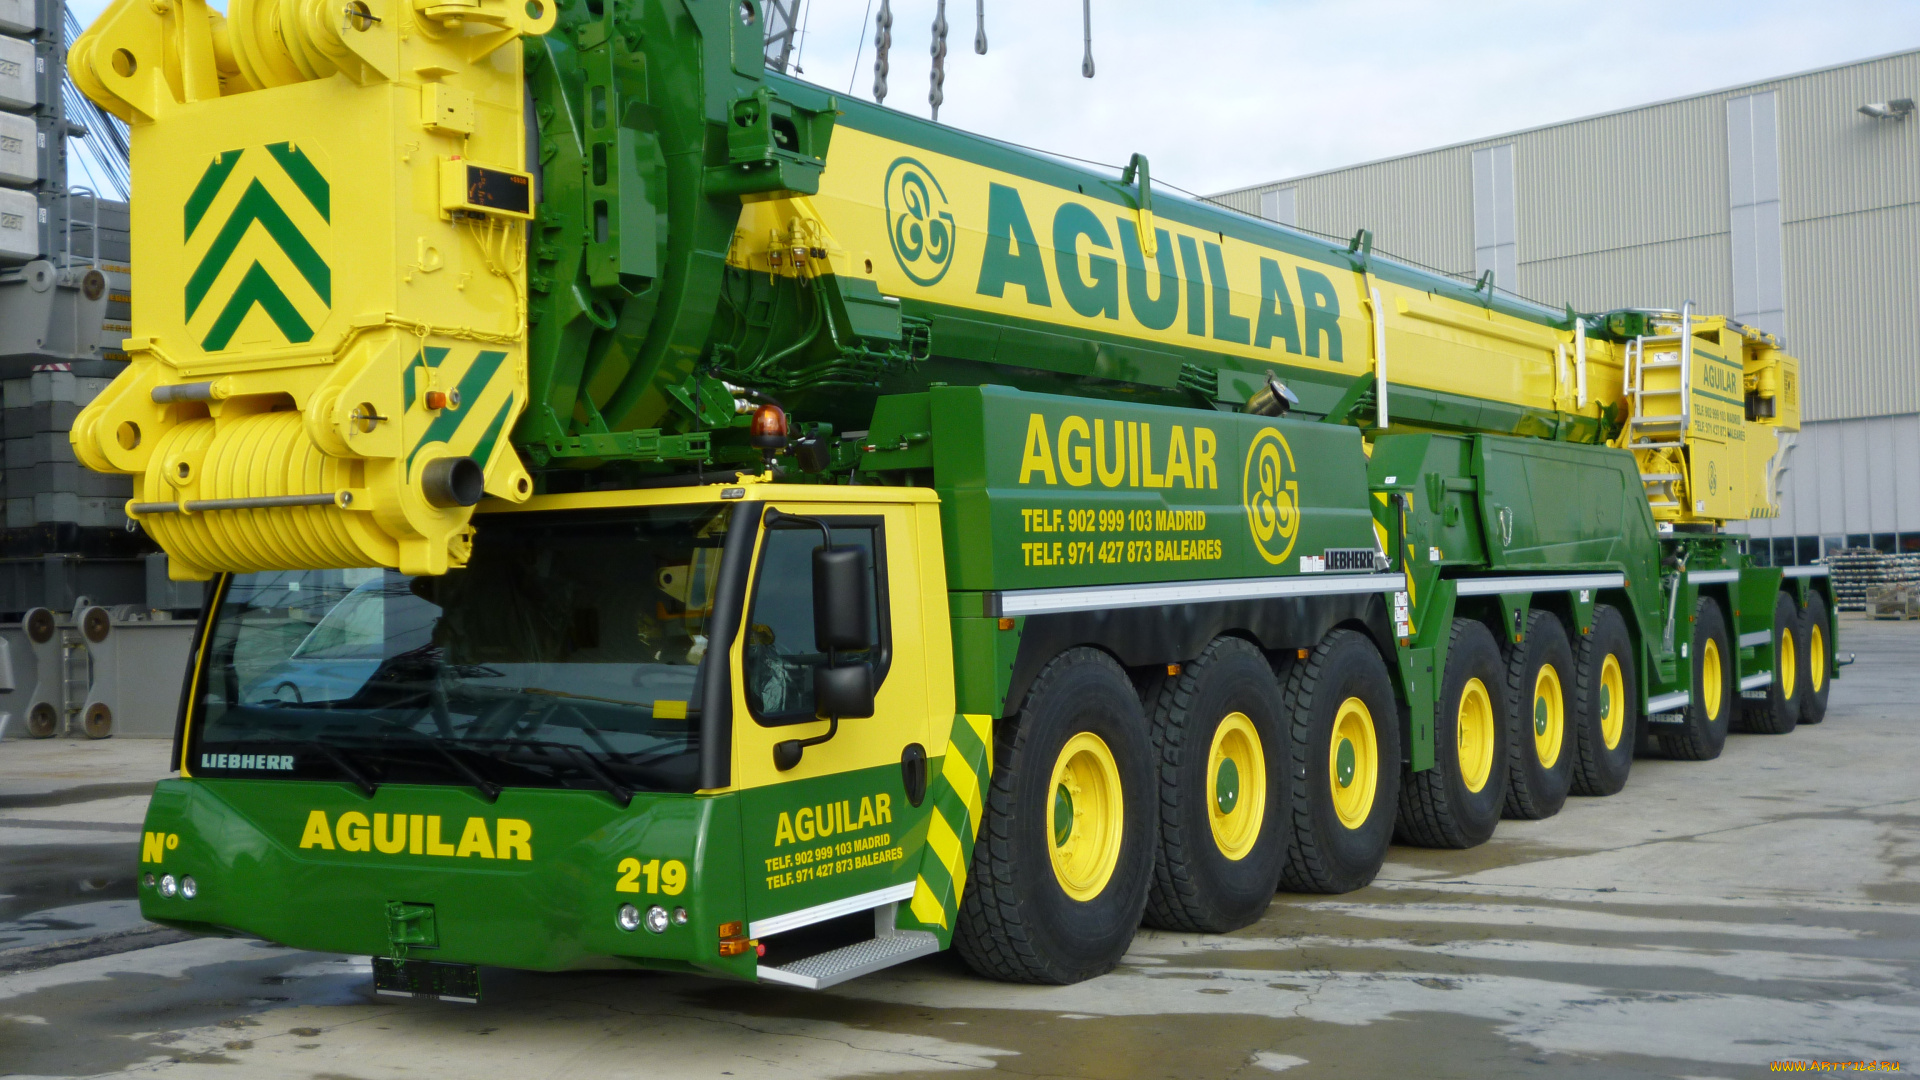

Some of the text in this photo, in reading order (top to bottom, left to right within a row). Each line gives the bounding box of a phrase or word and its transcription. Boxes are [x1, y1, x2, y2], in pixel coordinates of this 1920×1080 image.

[976, 182, 1343, 363] AGUILAR
[1704, 364, 1736, 394] AGUILAR
[1727, 412, 1741, 425] MADRID
[1019, 413, 1219, 489] AGUILAR
[1021, 508, 1206, 532] TELF. 902 999 103 MADRID
[1021, 539, 1222, 566] TELF. 971 427 873 BALEARES
[1325, 550, 1374, 570] LIEBHERR
[202, 753, 293, 770] LIEBHERR
[300, 810, 533, 861] AGUILAR
[774, 793, 892, 847] AGUILAR
[765, 833, 891, 873] TELF. 902 999 103 MADRID
[766, 846, 904, 890] TELF. 971 427 873 BALEARES
[616, 857, 687, 896] 219
